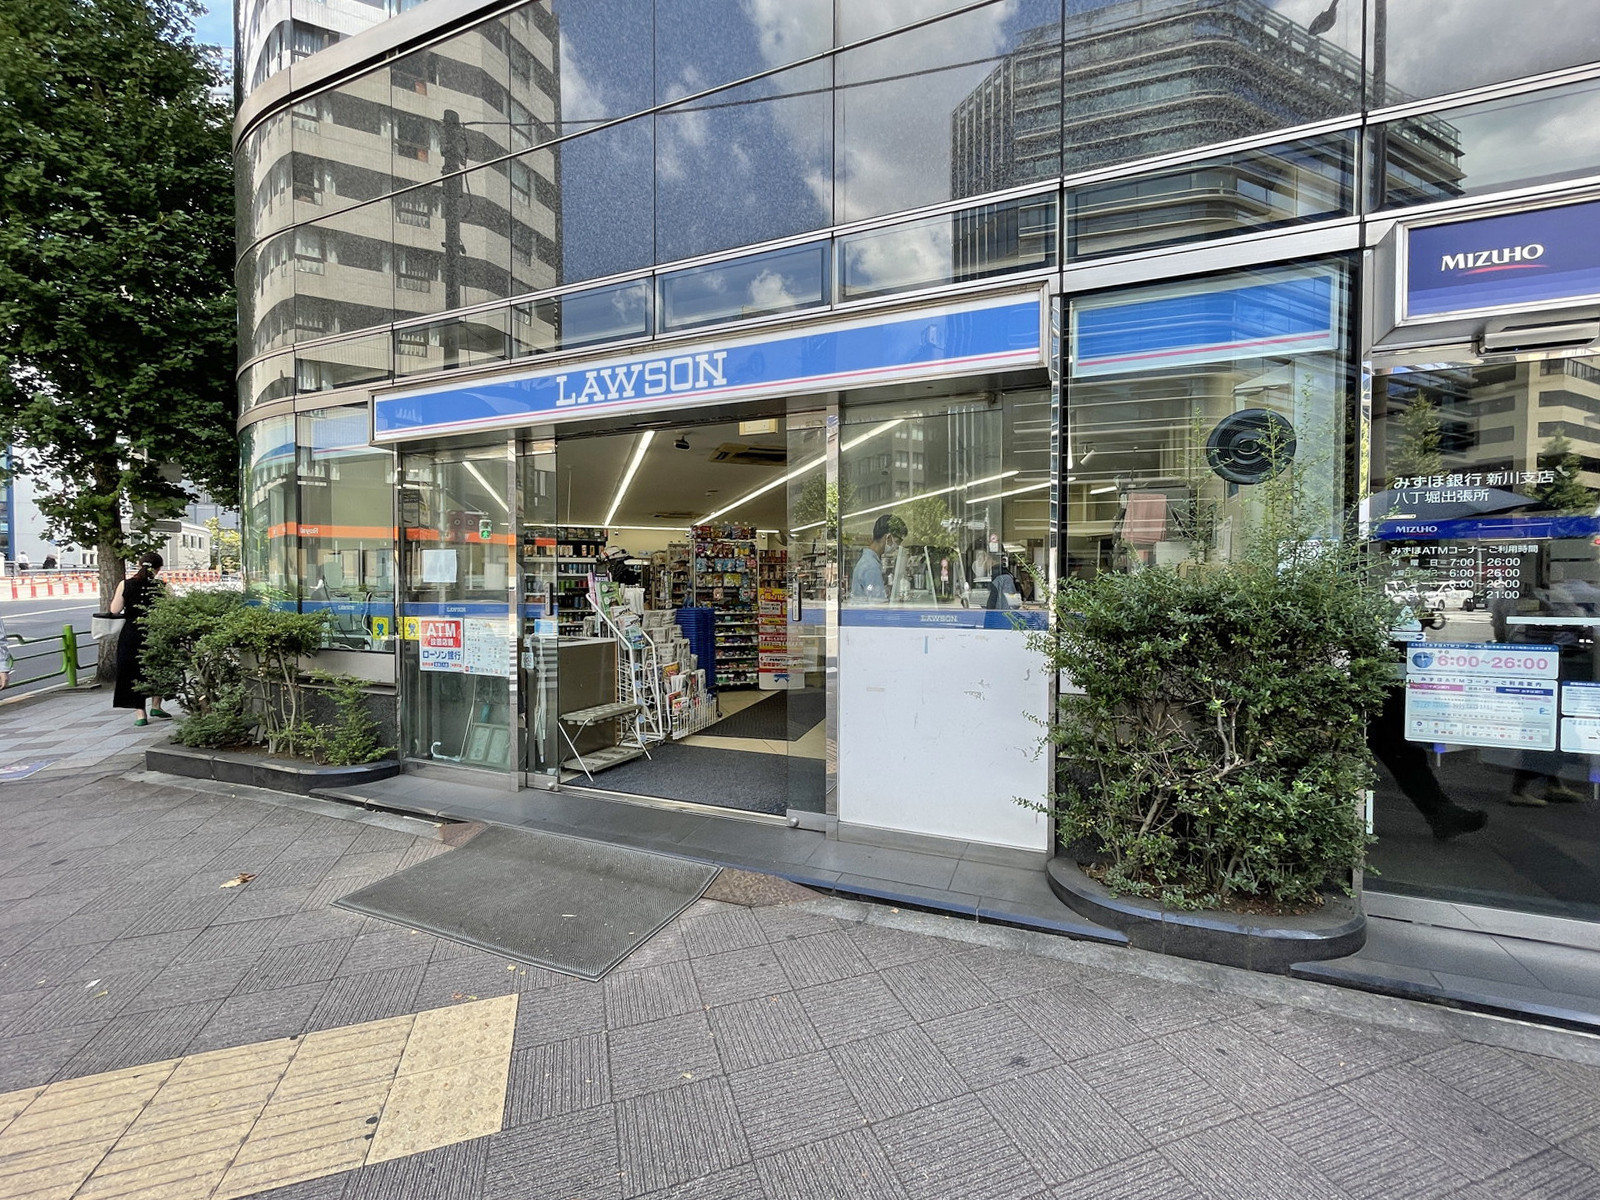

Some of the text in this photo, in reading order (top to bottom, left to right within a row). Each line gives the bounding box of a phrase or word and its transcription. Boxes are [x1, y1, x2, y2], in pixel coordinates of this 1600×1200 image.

[1441, 244, 1544, 271] MIZUHO
[556, 351, 728, 407] LAWSON
[1393, 470, 1555, 490] みずほ銀行 新川支店
[1393, 488, 1490, 505] 八丁堀出張所
[1395, 525, 1438, 534] MIZUHO
[920, 615, 958, 623] LAWSON
[427, 622, 456, 638] ATM
[422, 650, 461, 661] ローソン銀行
